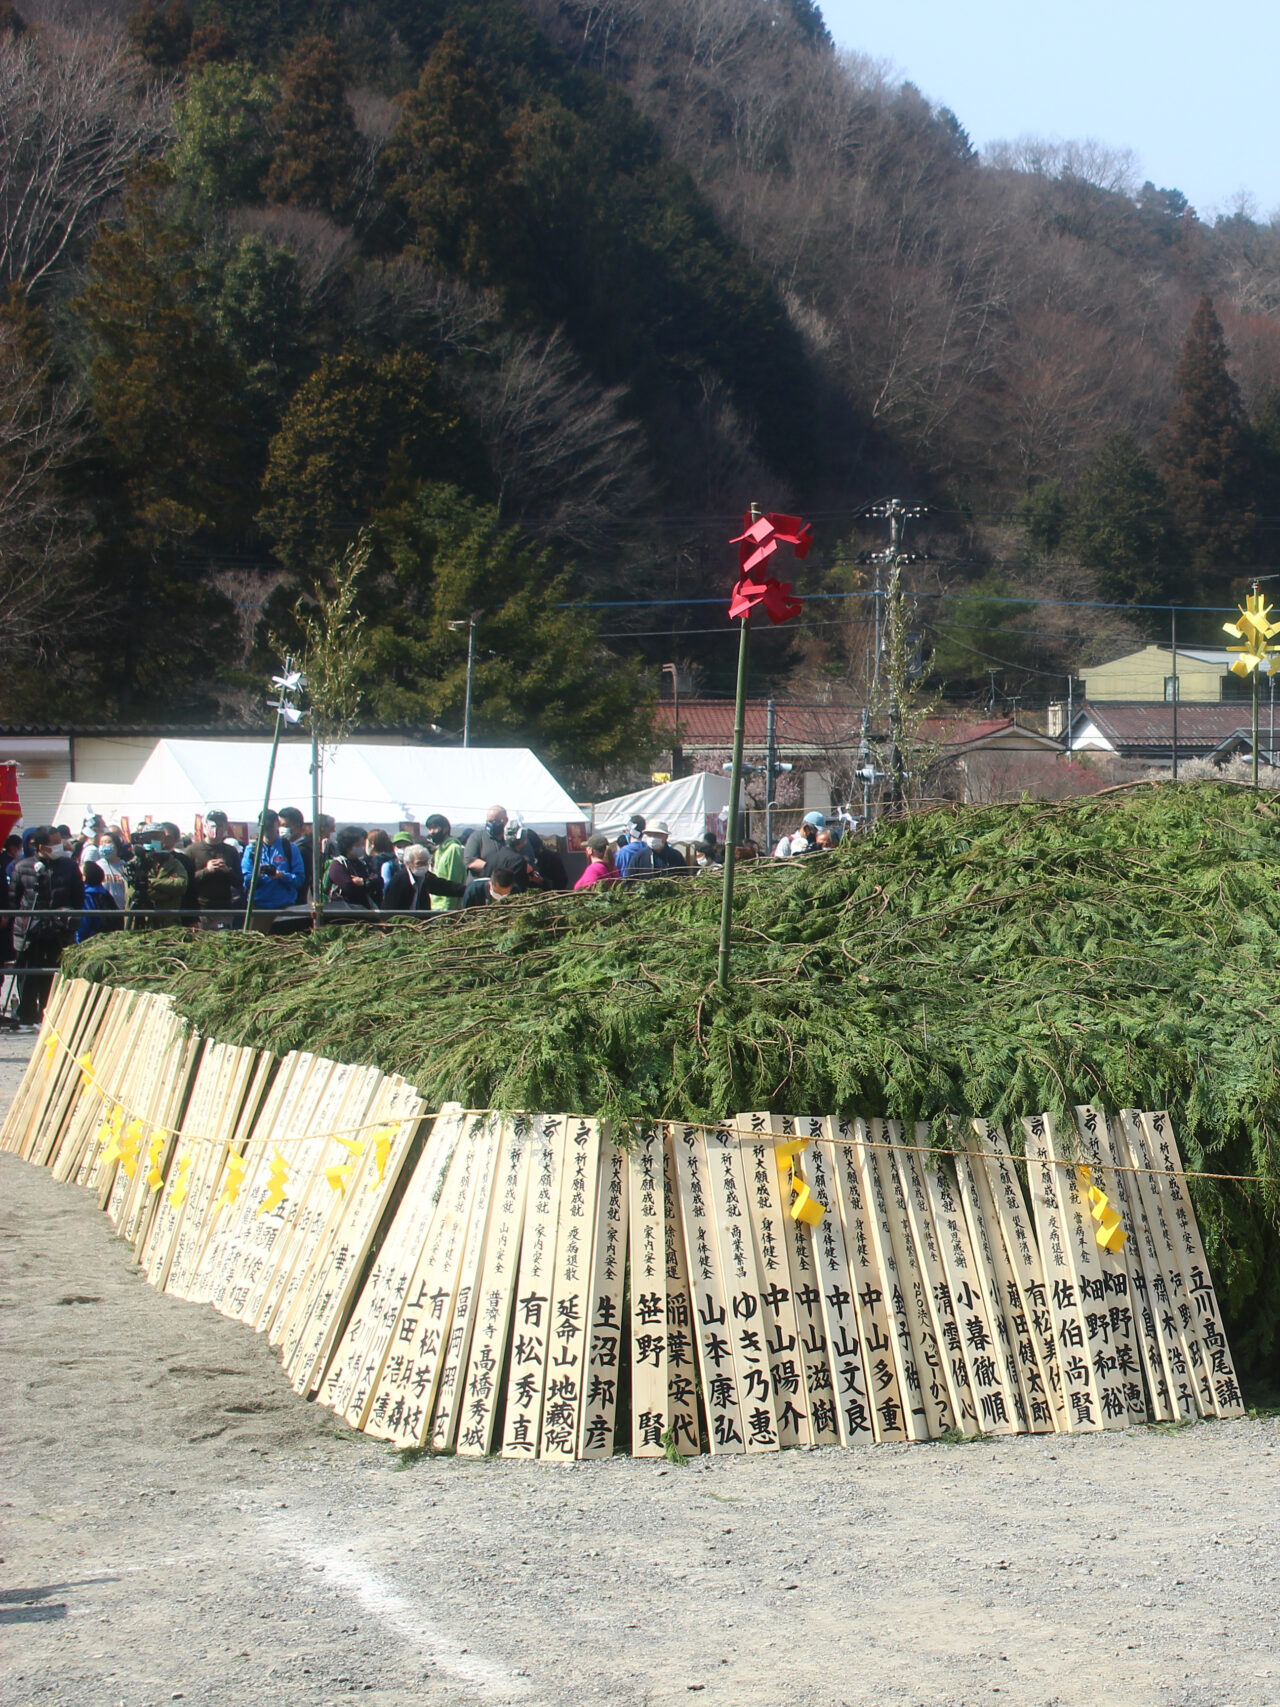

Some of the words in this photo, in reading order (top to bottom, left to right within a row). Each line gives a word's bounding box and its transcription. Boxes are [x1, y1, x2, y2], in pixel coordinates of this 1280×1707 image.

[502, 1148, 523, 1214] 祈大願成就
[535, 1148, 554, 1214] 祈大願成就
[569, 1152, 588, 1217] 祈大願成就
[606, 1154, 624, 1222] 祈大願成就
[640, 1154, 657, 1217] 祈大願成就
[687, 1156, 705, 1218] 祈大願成就
[720, 1152, 742, 1217] 祈大願成就
[752, 1144, 772, 1209] 祈大願成就
[811, 1150, 833, 1214] 祈大願成就
[842, 1146, 864, 1210] 祈大願成就
[936, 1163, 957, 1214] 大願成就
[994, 1148, 1019, 1209] 祈大願成就
[1036, 1147, 1059, 1209] 祈大願成就
[1159, 1142, 1183, 1202] 祈大願成就
[887, 1150, 907, 1210] 祈大願成就
[913, 1282, 931, 1329] NPO法人
[906, 1152, 929, 1212] 祈大願成就
[922, 1219, 939, 1263] 身体健全
[530, 1224, 547, 1278] 家内安全
[564, 1226, 583, 1282] 疫病退散
[603, 1227, 620, 1281] 家内安全
[642, 1225, 657, 1278] 家内安全
[696, 1226, 715, 1280] 身体健全
[760, 1217, 781, 1271] 身体健全
[821, 1219, 841, 1272] 身体健全
[855, 1217, 872, 1268] 身体健全
[946, 1219, 968, 1269] 報恩感謝
[1047, 1215, 1067, 1267] 疫病退散
[402, 1286, 450, 1440] 有松芳枝
[505, 1291, 549, 1453] 有松秀真
[584, 1295, 620, 1450] 生沼邦彦
[697, 1293, 743, 1447] 山本康弘
[759, 1282, 808, 1435] 中山陽介
[794, 1283, 839, 1436] 中山滋樹
[825, 1284, 872, 1437] 中山文良
[858, 1281, 902, 1433] 中山多重
[956, 1281, 1010, 1425] 小暮徹順
[1052, 1278, 1097, 1425] 佐伯尚賢
[1079, 1275, 1126, 1420] 畑野和裕
